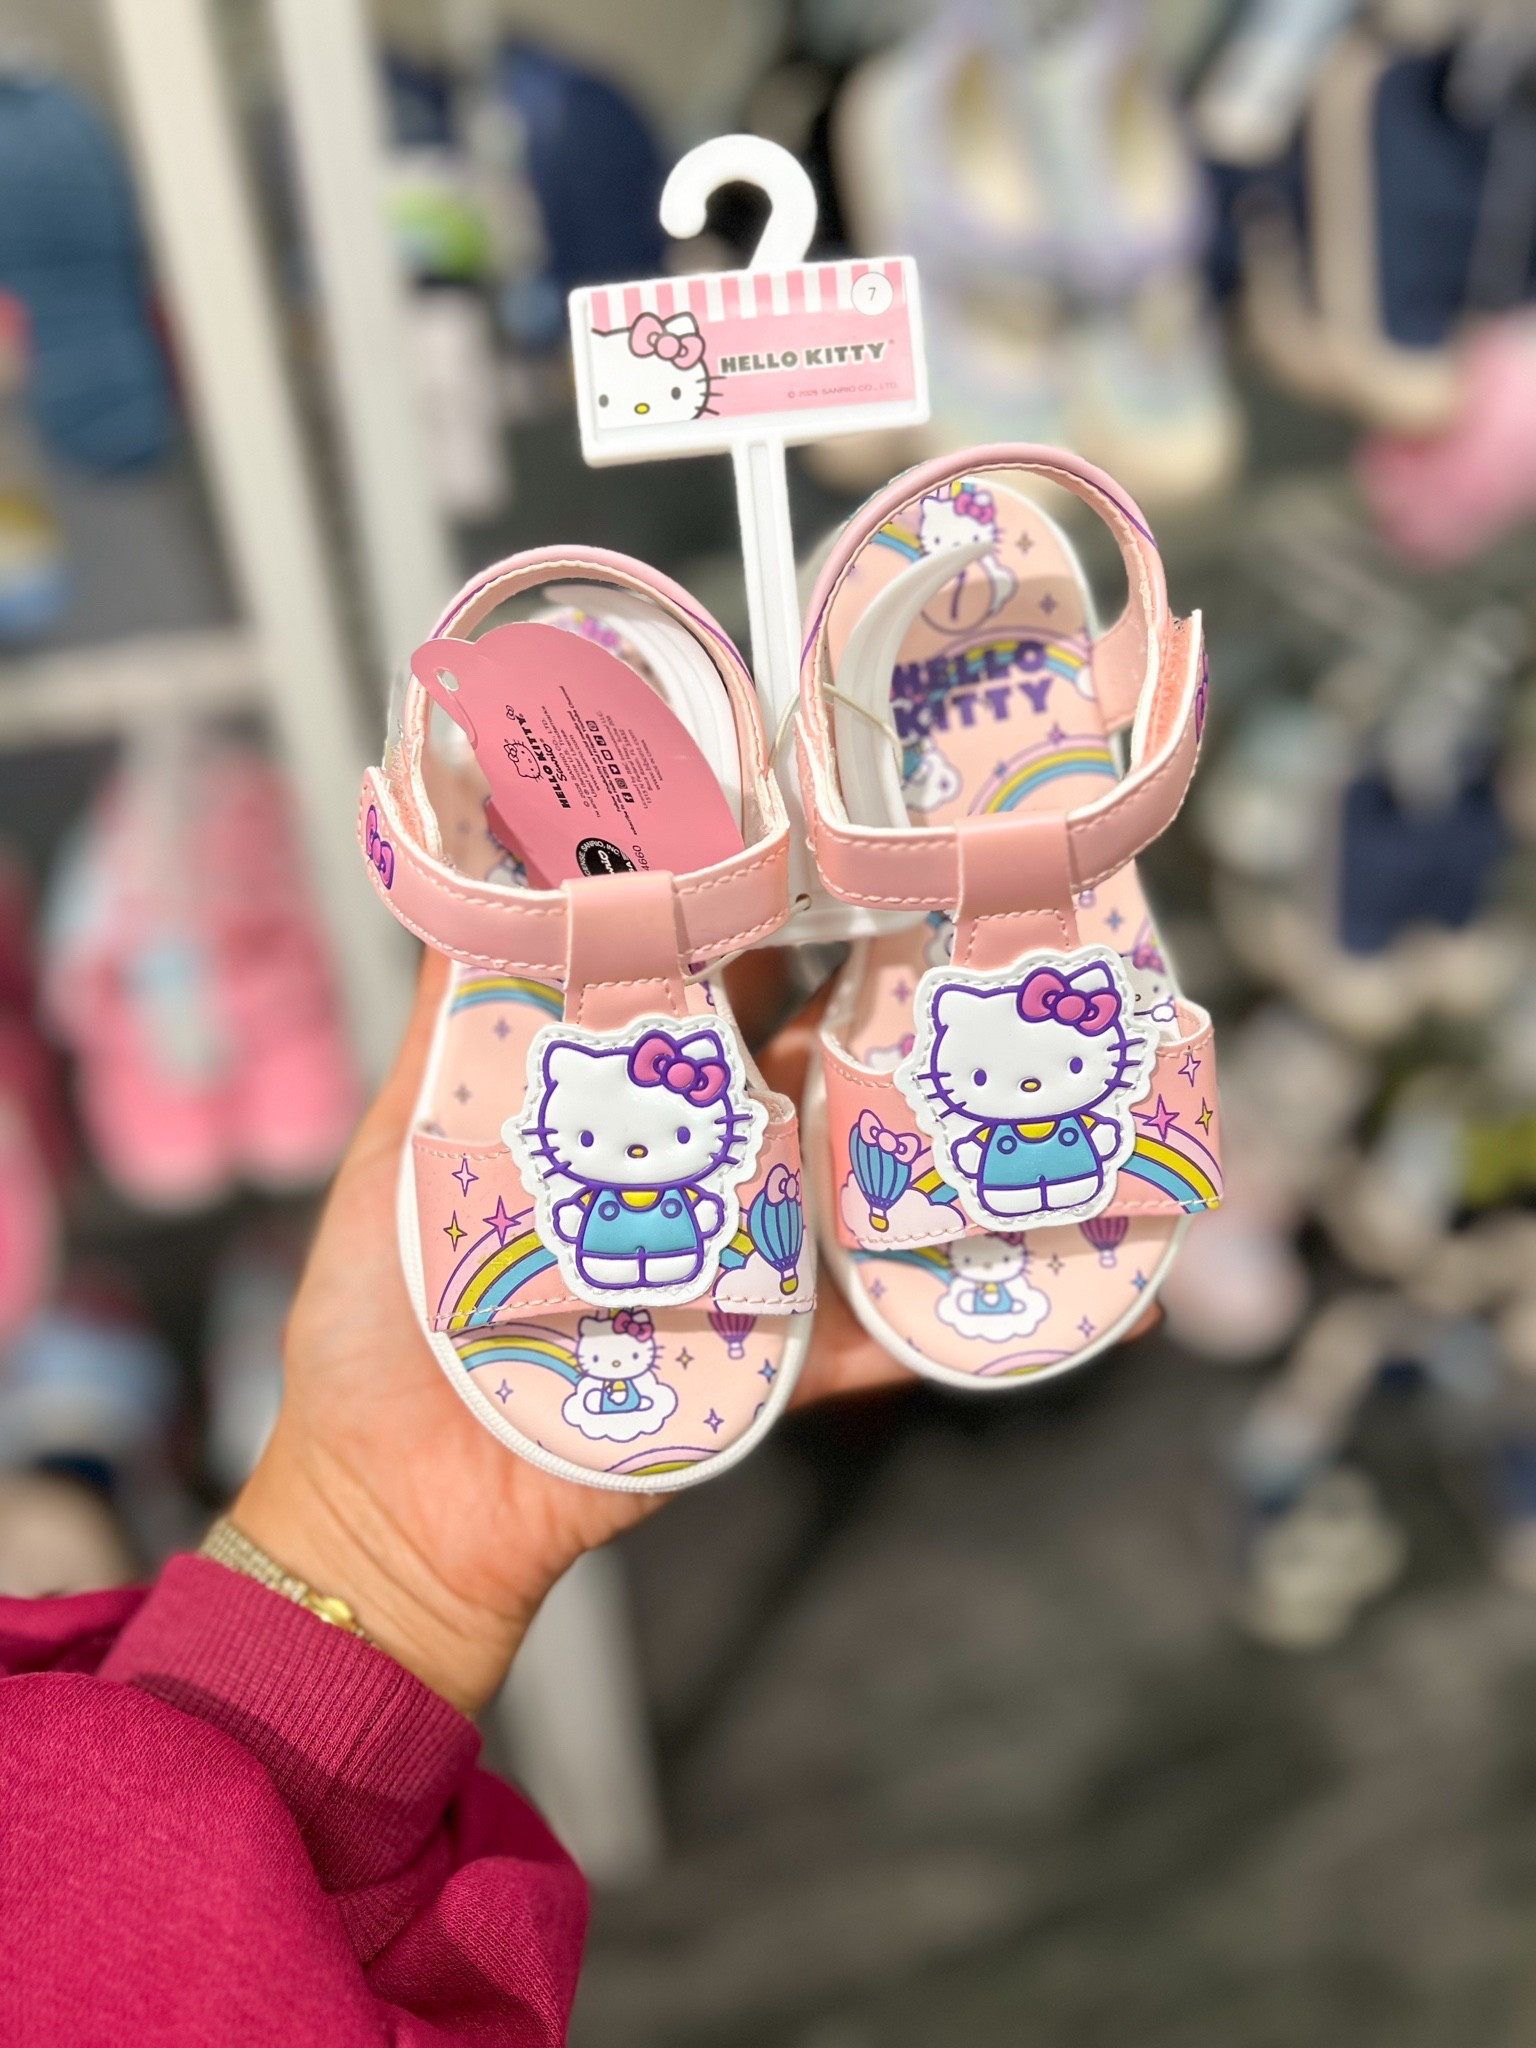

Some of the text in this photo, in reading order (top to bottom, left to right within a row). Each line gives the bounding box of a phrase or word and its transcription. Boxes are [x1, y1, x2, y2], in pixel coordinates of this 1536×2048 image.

[868, 287, 876, 301] 7
[720, 342, 885, 374] HELLO KITTY
[821, 384, 856, 395] SANRIO
[890, 640, 1046, 701] HELLO
[893, 677, 1053, 738] KITTY
[515, 714, 571, 808] HELLO KITTY
[541, 743, 568, 781] Sanrio
[558, 752, 576, 780] SANRIO
